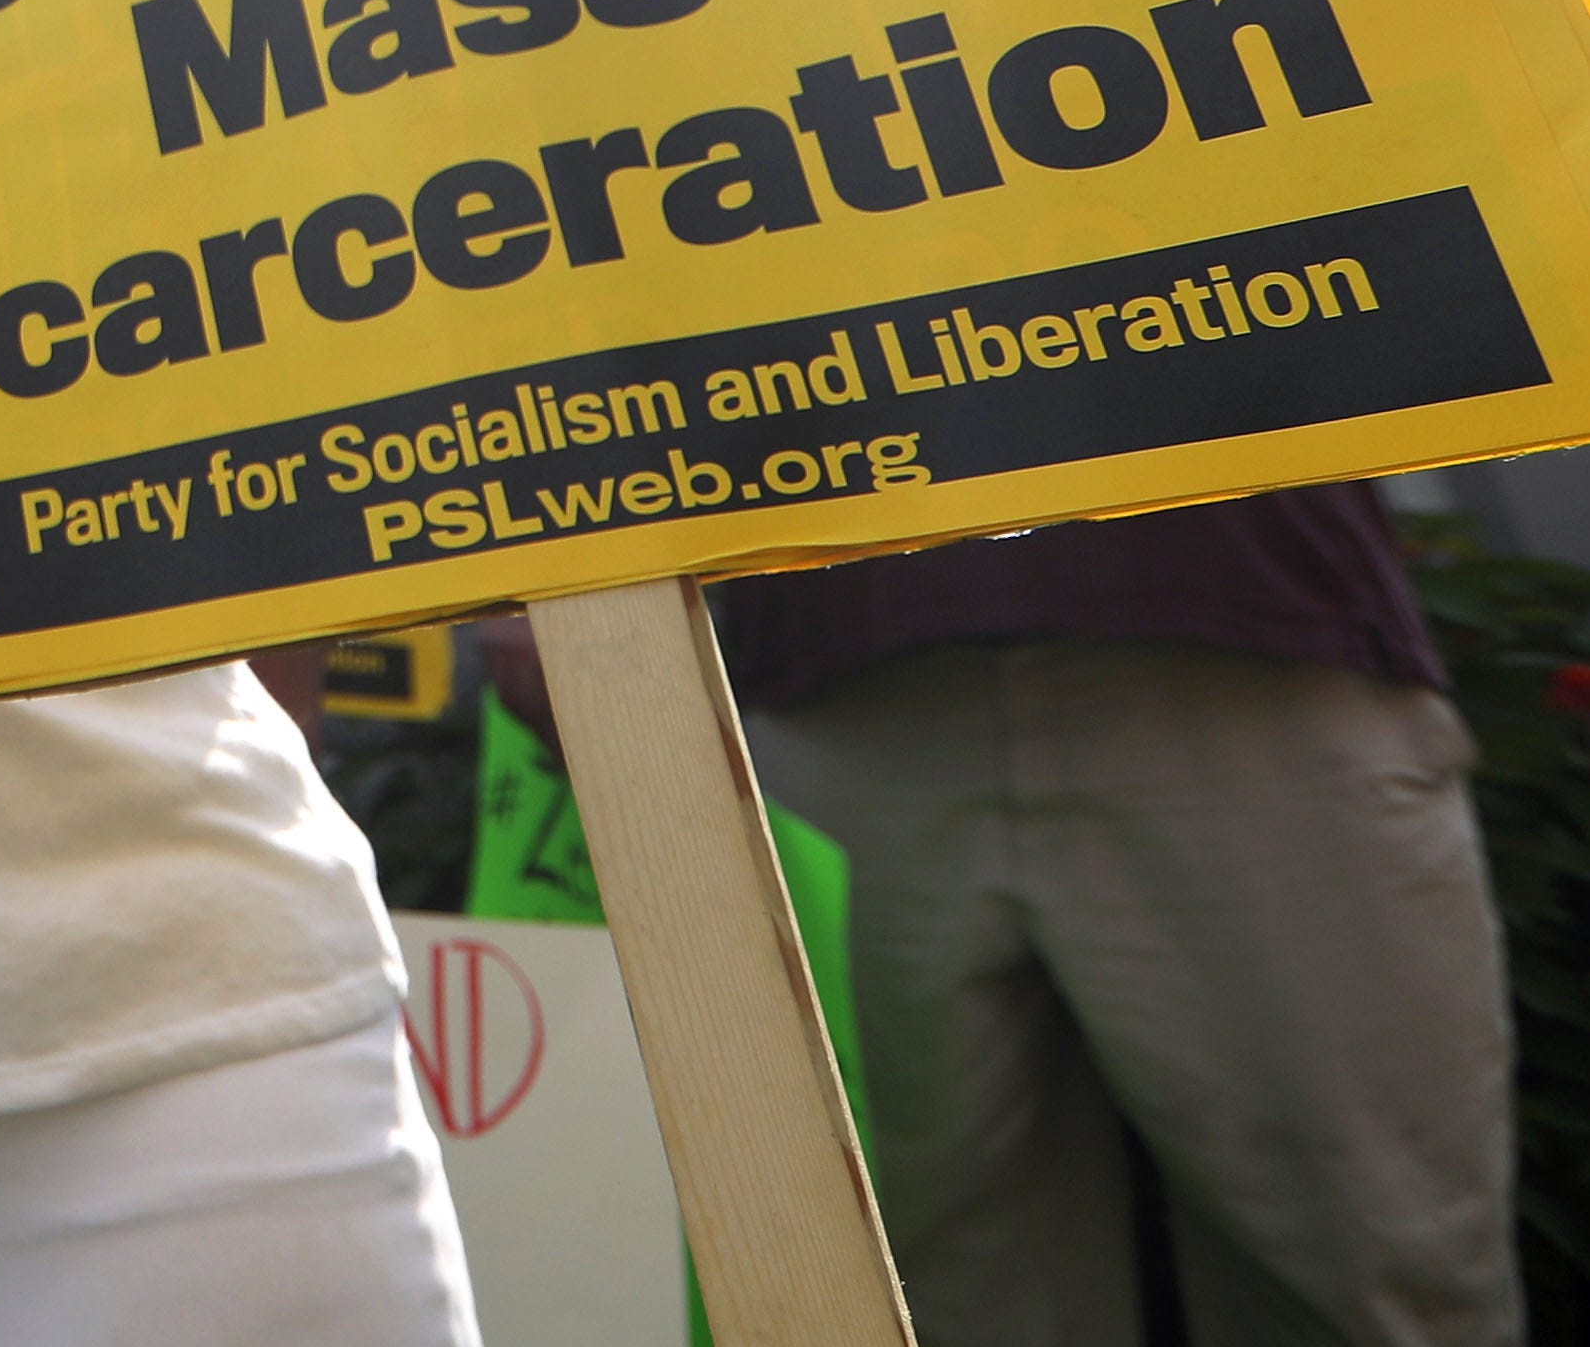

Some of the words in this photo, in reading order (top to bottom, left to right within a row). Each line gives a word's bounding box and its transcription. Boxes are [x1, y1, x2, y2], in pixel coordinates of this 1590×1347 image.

[20, 469, 194, 554] Party
[208, 448, 308, 519] for
[319, 377, 688, 494] Socialism
[704, 331, 867, 423] and
[875, 254, 1381, 396] Liberation
[362, 427, 933, 563] PSLweb.org
